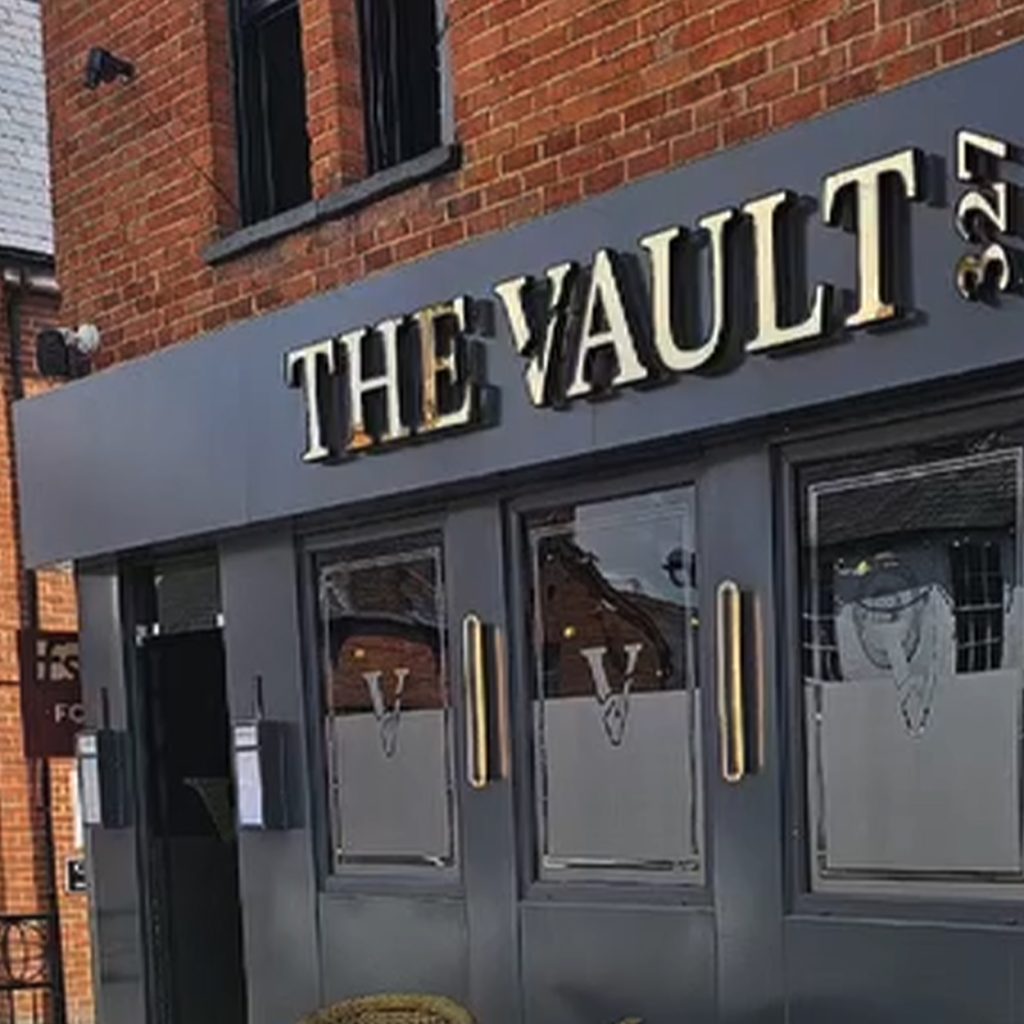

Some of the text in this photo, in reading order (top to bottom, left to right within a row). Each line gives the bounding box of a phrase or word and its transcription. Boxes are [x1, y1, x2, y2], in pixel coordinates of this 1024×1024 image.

[285, 147, 919, 462] THE VAULT
[956, 130, 1010, 299] 327
